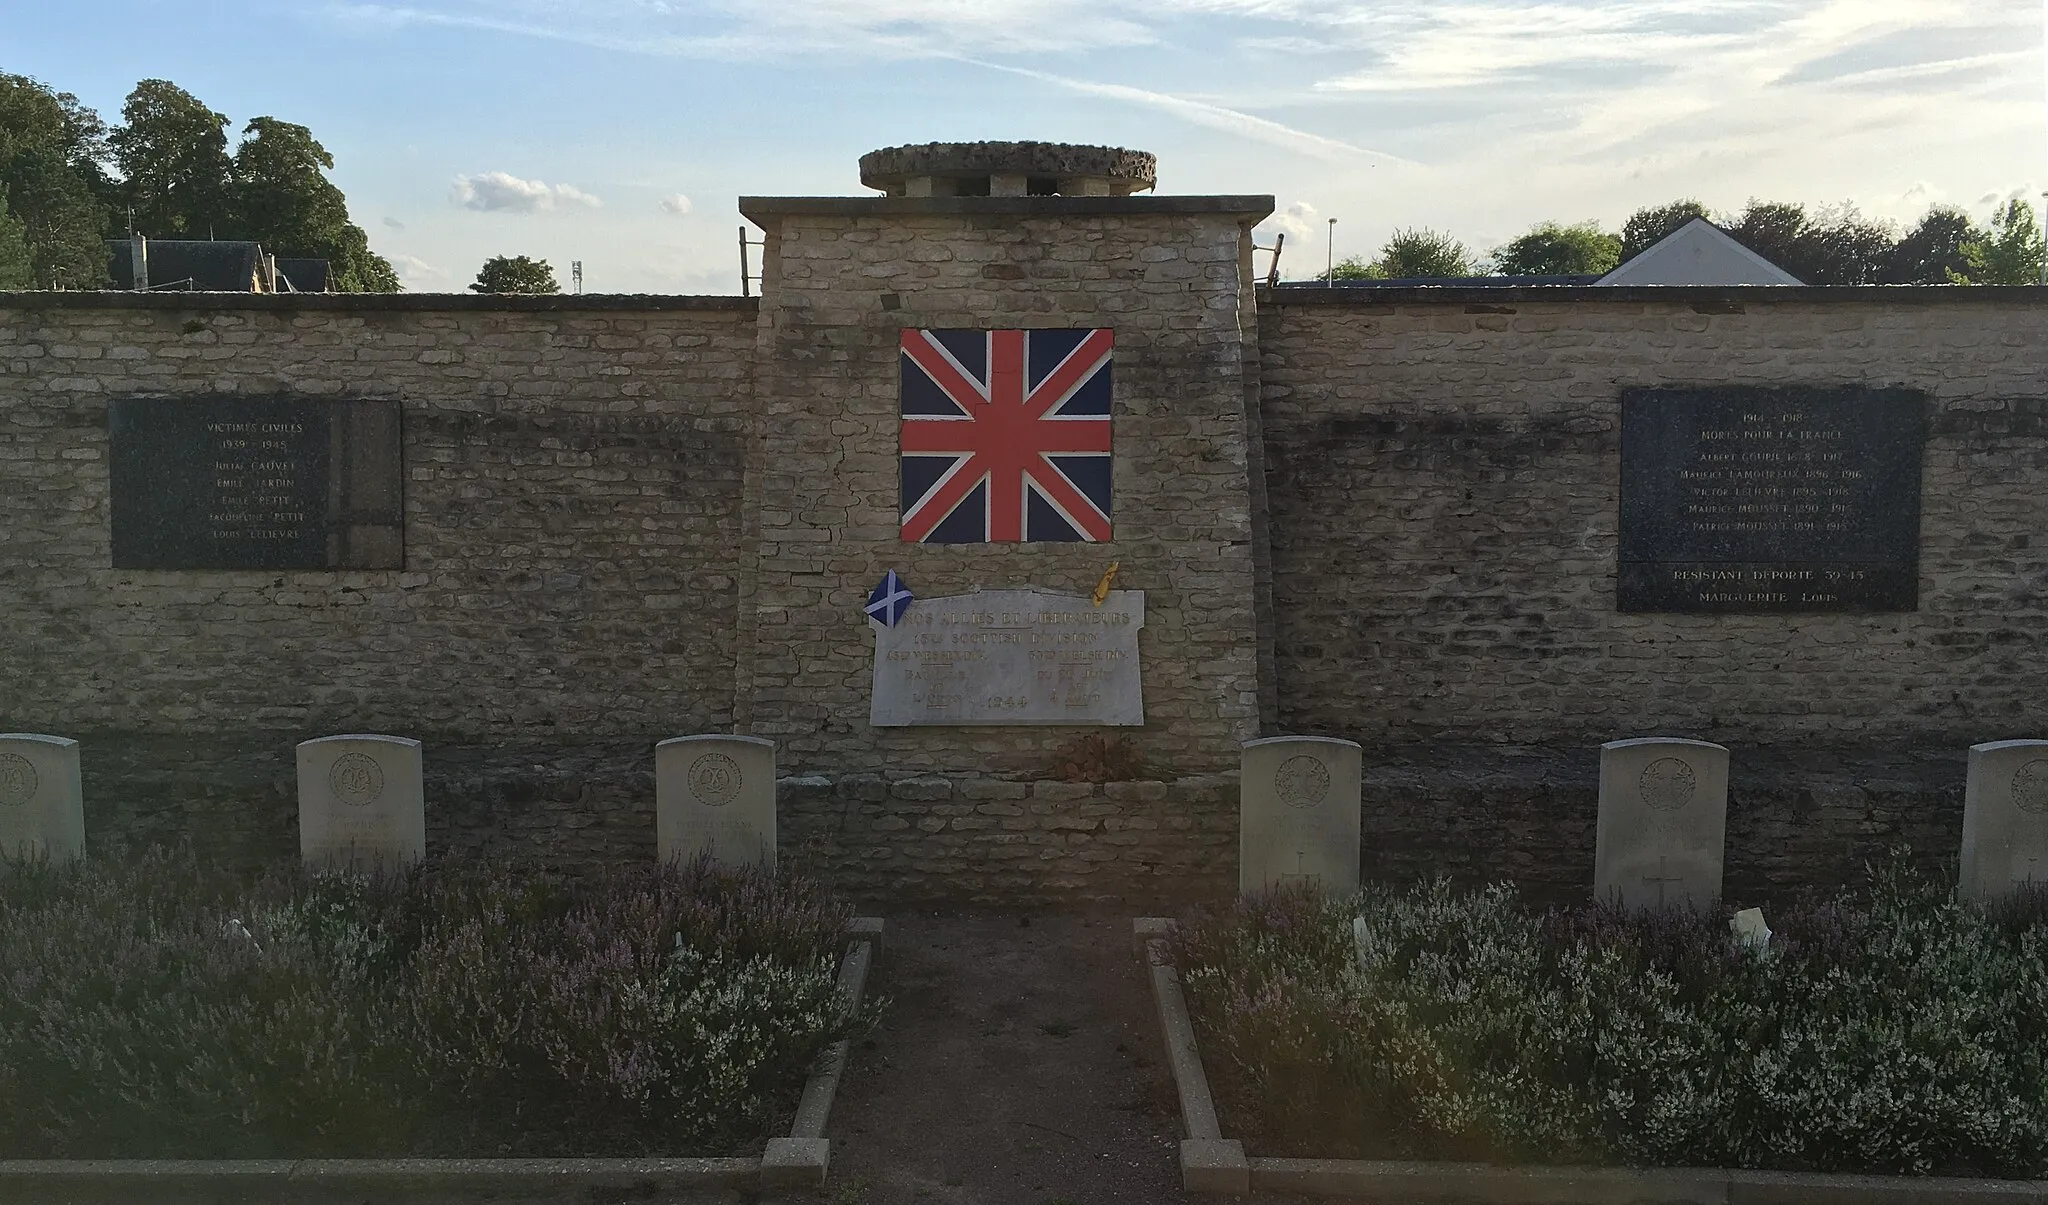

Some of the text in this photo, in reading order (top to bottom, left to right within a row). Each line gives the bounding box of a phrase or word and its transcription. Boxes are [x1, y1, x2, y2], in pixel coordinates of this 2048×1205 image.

[1743, 413, 1765, 423] 1914
[1782, 413, 1804, 423] 1918
[207, 423, 303, 433] VICTIMES CIVILES
[1701, 430, 1843, 440] MORTS POUR LA FRANCE
[222, 439, 287, 450] 1939 1945
[1699, 452, 1735, 462] ALBERT
[258, 496, 290, 505] PETIT
[274, 512, 304, 522] PETIT
[1673, 570, 1743, 580] RESISTANT
[1753, 570, 1814, 580] DEPORTE
[1699, 592, 1788, 603] MARGUERITE
[903, 612, 935, 625] NOS
[1002, 612, 1021, 625] ET
[951, 632, 1022, 645] SCOTTISH
